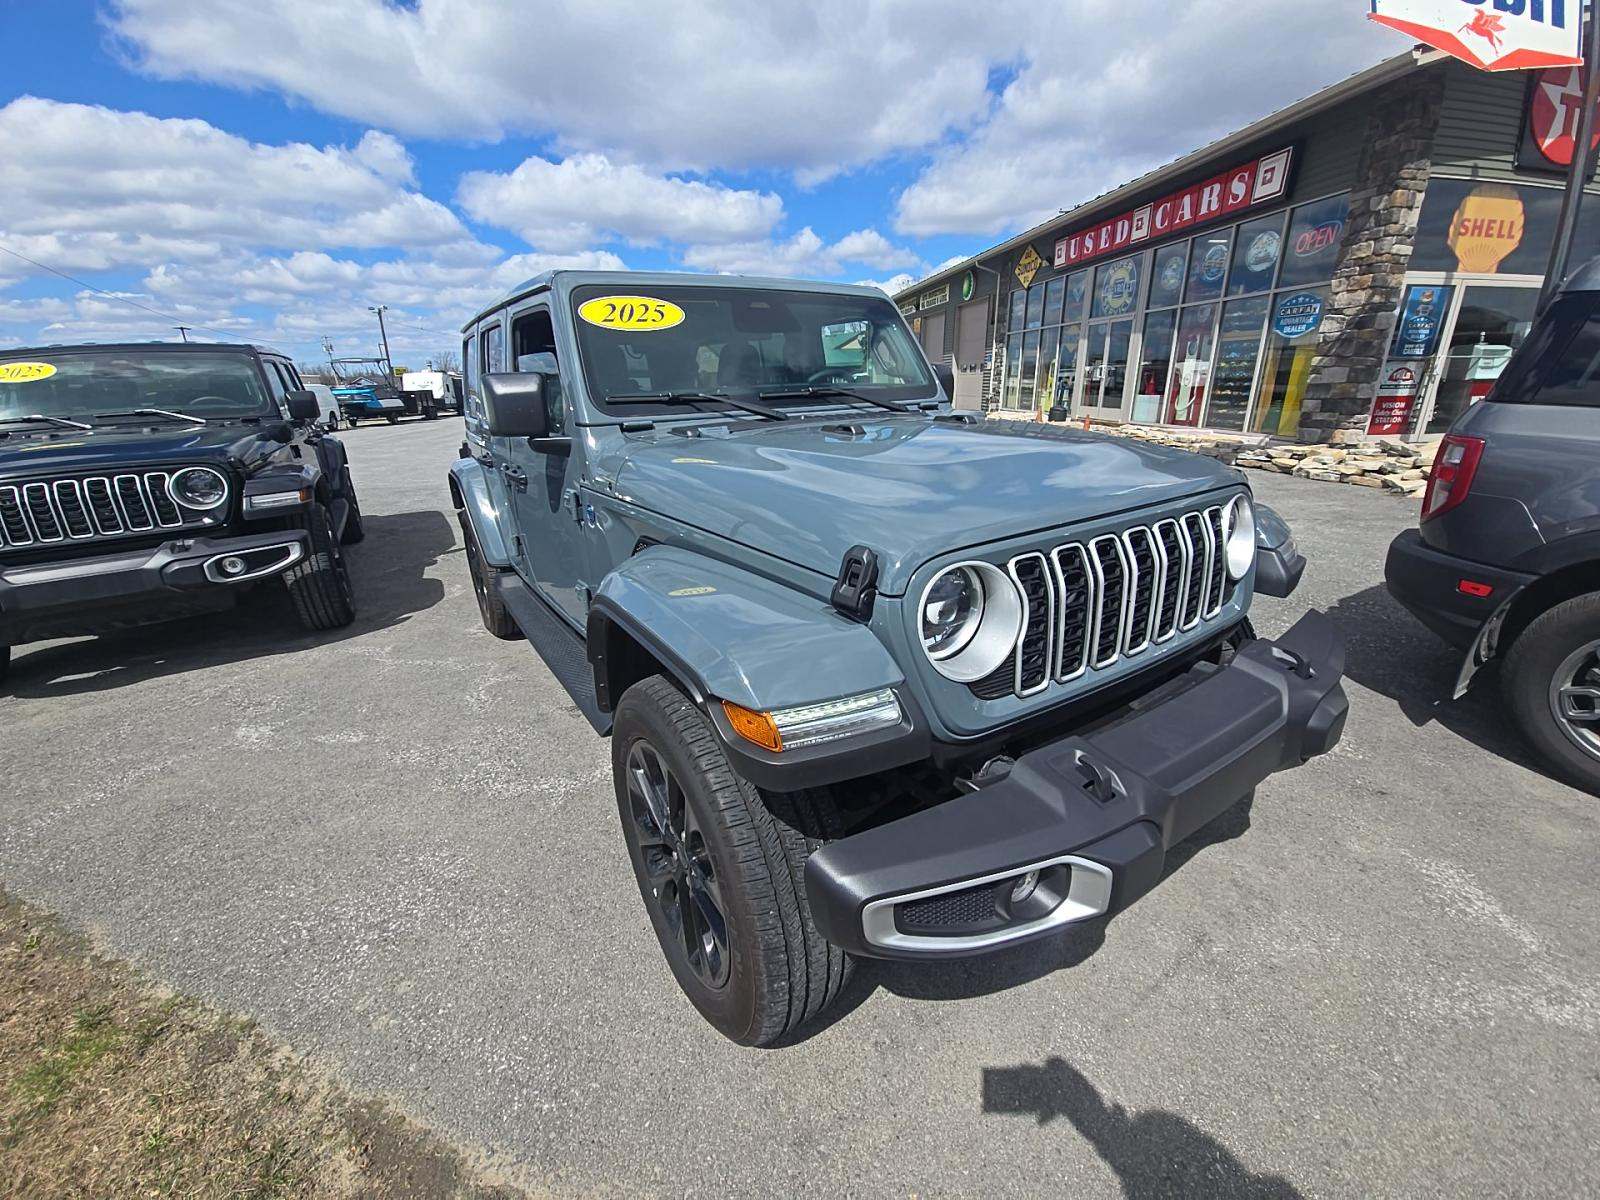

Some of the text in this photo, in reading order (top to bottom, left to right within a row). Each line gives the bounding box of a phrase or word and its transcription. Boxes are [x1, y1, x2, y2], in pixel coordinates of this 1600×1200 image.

[1070, 172, 1249, 259] USED CARS
[1458, 217, 1516, 240] SHELL
[1296, 224, 1338, 254] OPEN
[601, 302, 666, 324] 2025
[1280, 303, 1320, 316] CARFAX
[1283, 324, 1307, 333] DEALER
[0, 365, 44, 379] 2025
[1375, 416, 1403, 424] STATION
